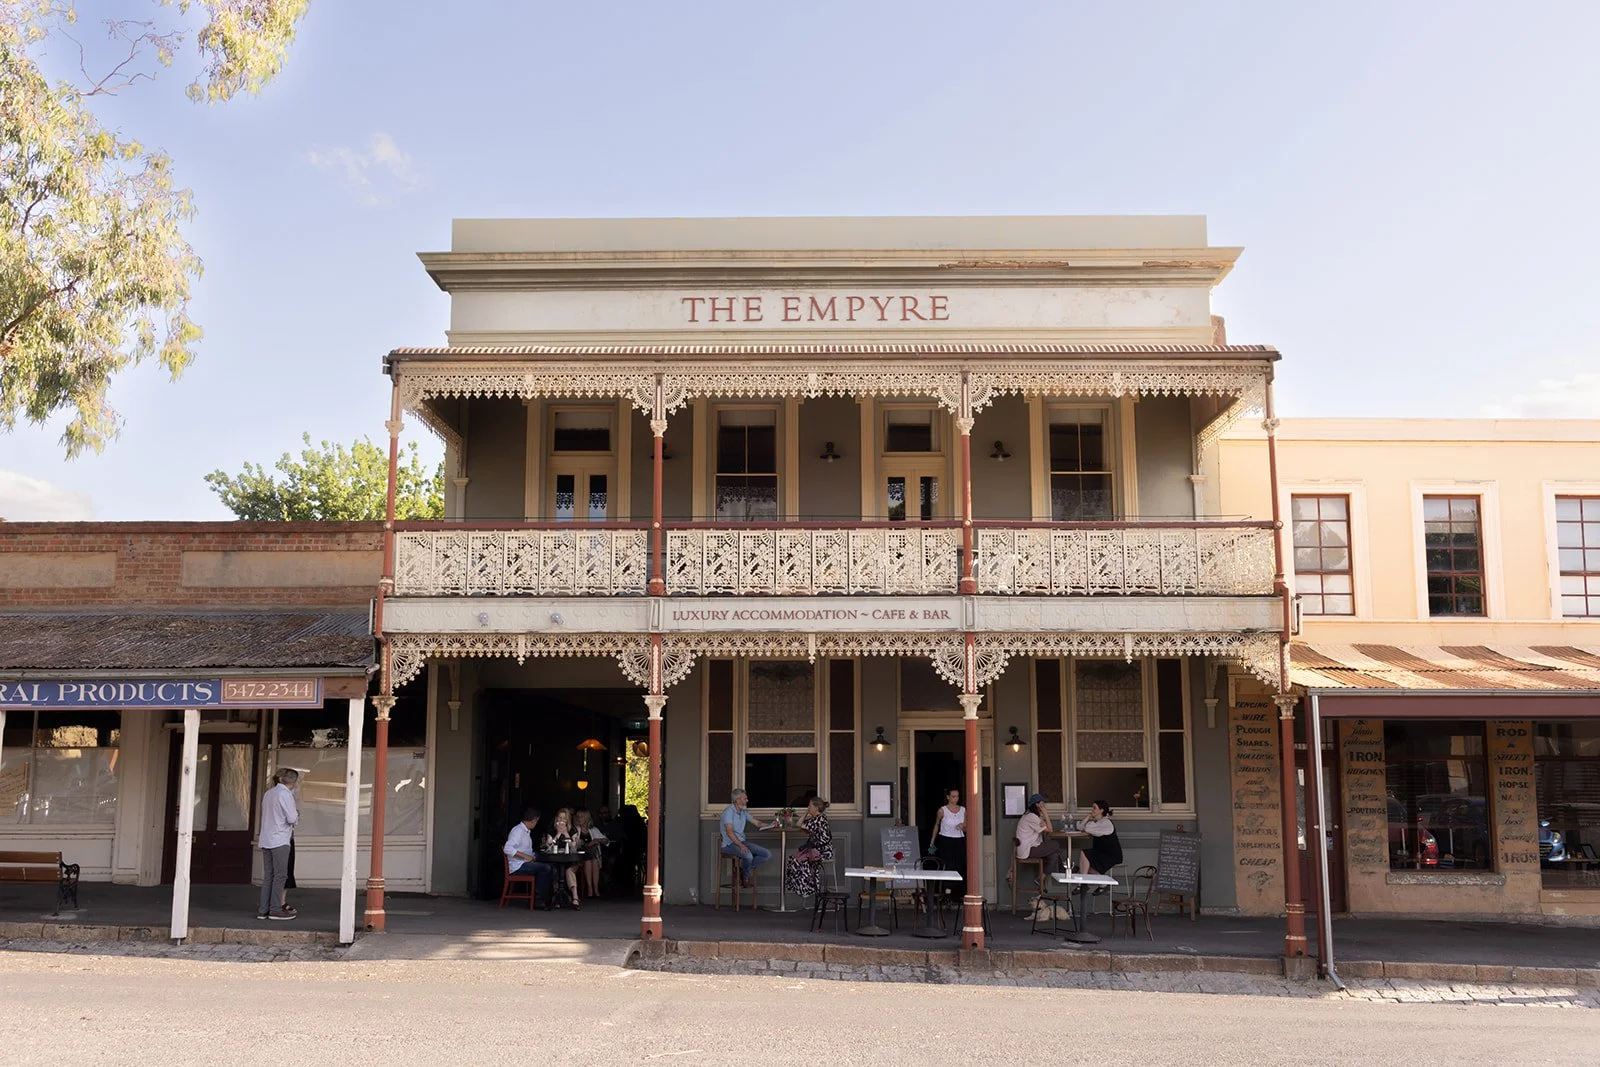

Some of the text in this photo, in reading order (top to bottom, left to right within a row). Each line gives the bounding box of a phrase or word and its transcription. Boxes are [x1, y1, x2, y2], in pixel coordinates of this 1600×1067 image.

[681, 295, 951, 323] THE EMPYRE
[673, 609, 729, 621] LUXURY
[732, 609, 858, 621] ACCOMMODATION
[872, 609, 906, 620] CAFE
[909, 609, 919, 620] &
[923, 609, 951, 620] BAR
[58, 682, 213, 702] PRODUCTS
[228, 683, 311, 697] 5472 2344
[1236, 725, 1271, 734] PLOUGH
[1497, 728, 1528, 737] ROD
[1499, 766, 1533, 776] IRON.
